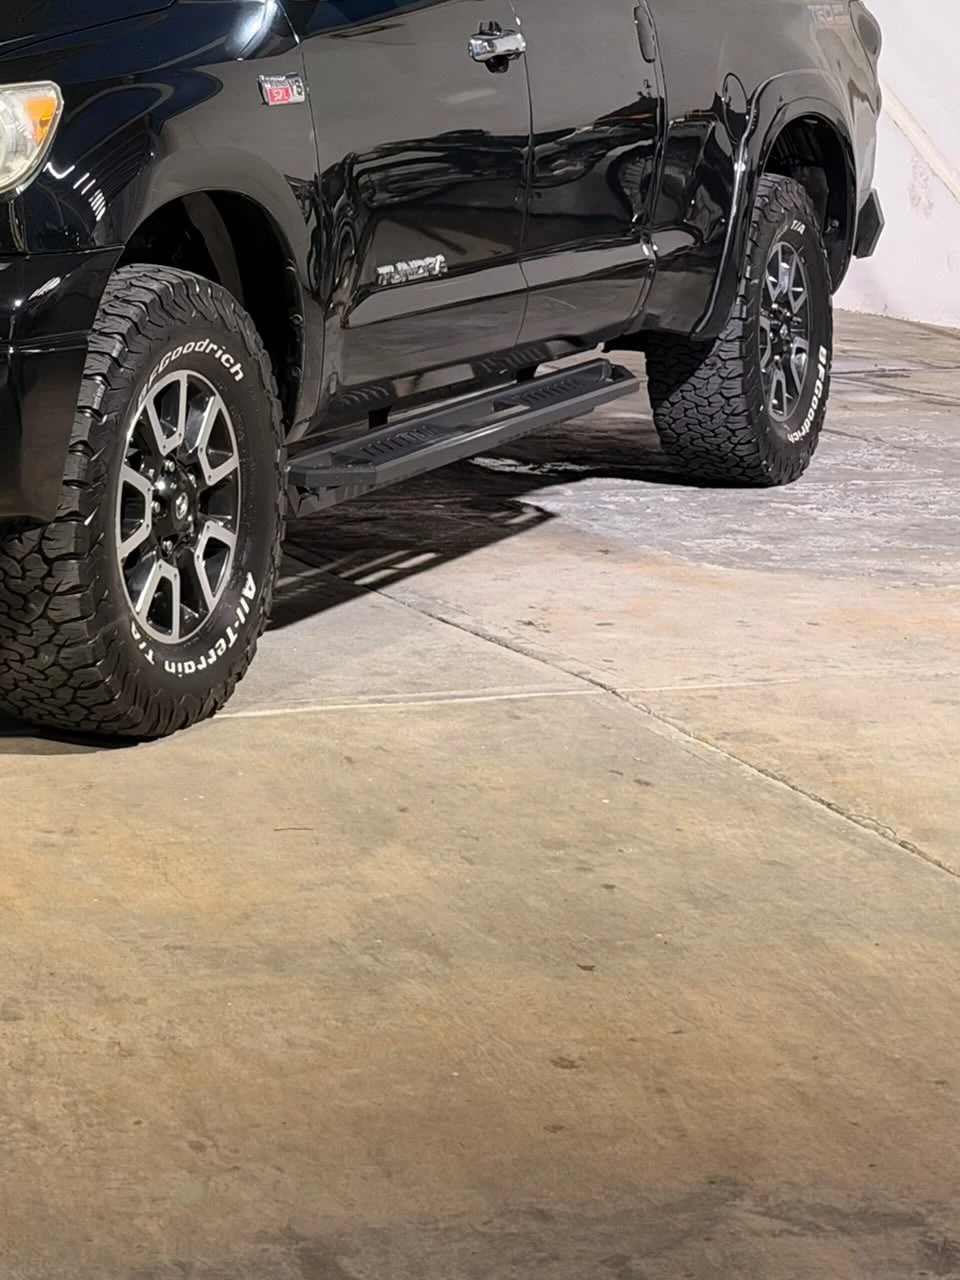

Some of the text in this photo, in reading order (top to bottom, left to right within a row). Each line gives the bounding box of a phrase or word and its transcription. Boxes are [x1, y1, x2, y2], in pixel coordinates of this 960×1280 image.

[790, 219, 806, 235] T/A
[786, 344, 827, 444] BFGoodrich
[163, 571, 257, 677] All-Terrain
